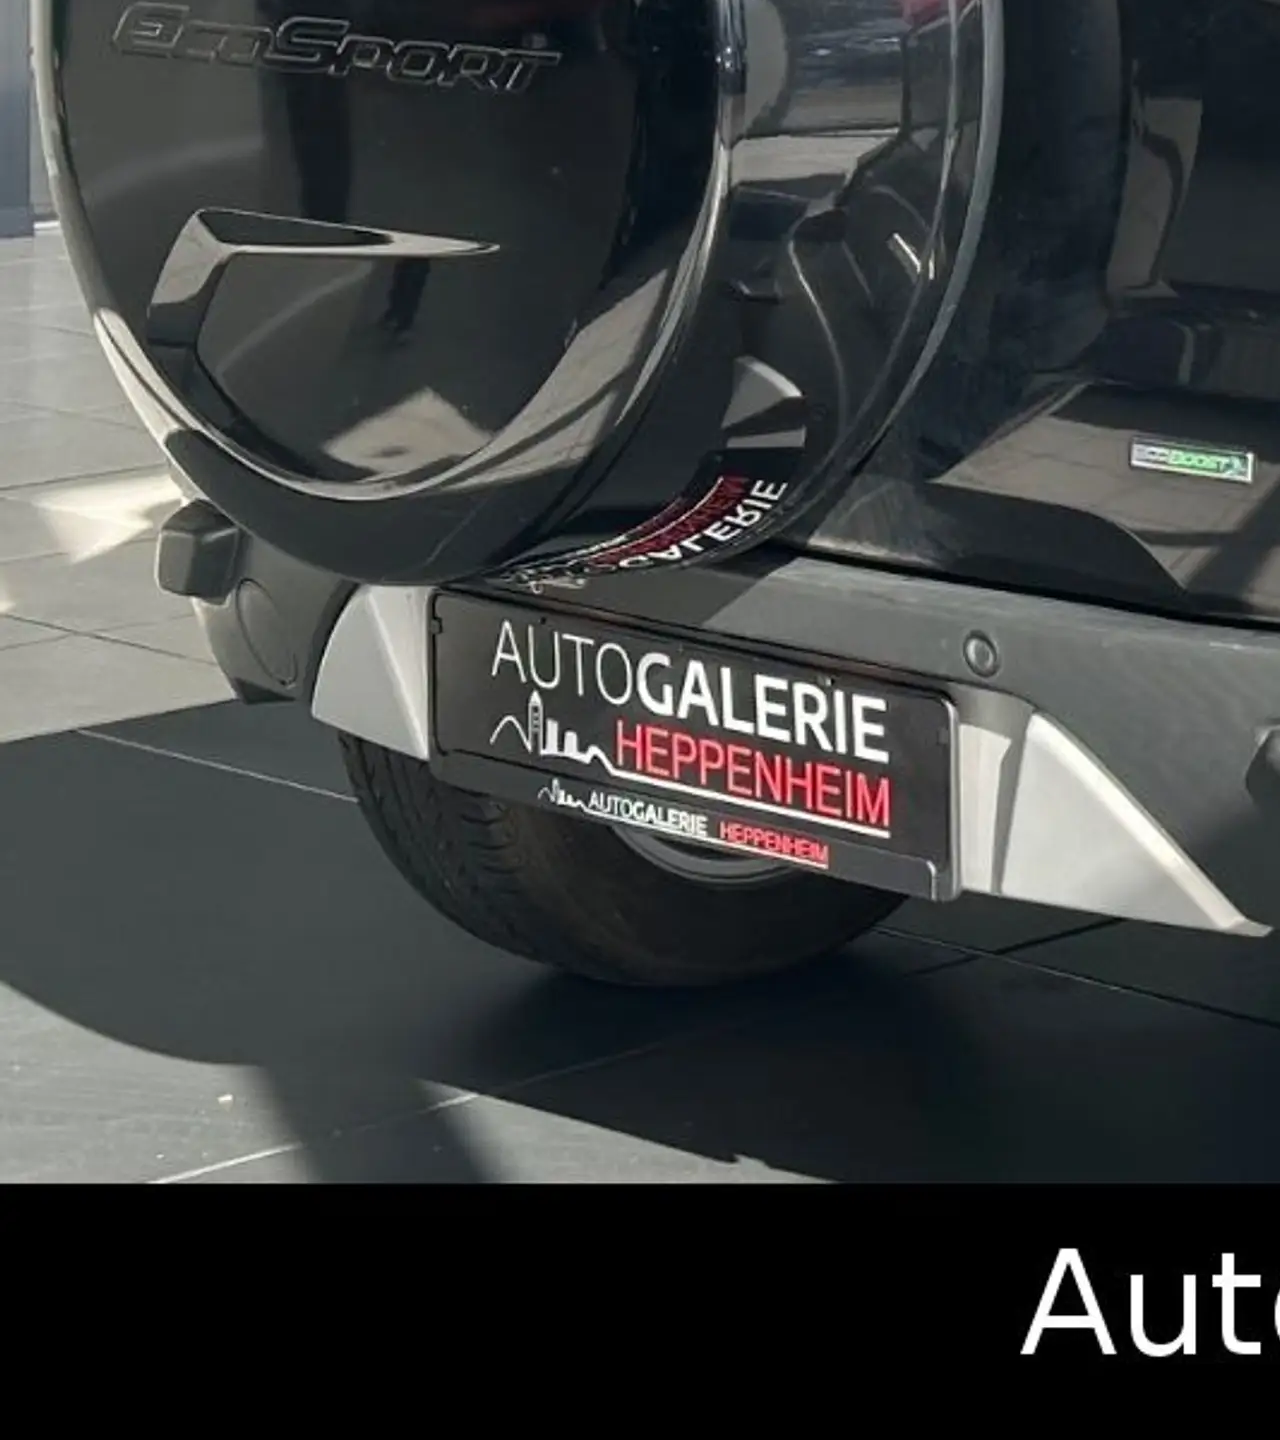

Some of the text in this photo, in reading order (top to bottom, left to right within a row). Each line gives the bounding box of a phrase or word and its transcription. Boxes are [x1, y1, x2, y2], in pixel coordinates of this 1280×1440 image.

[490, 620, 890, 763] AUTOGALERIE
[588, 787, 830, 867] AUTOGALERIE HEPPENHEIM
[614, 720, 891, 828] HEPPENHEIM
